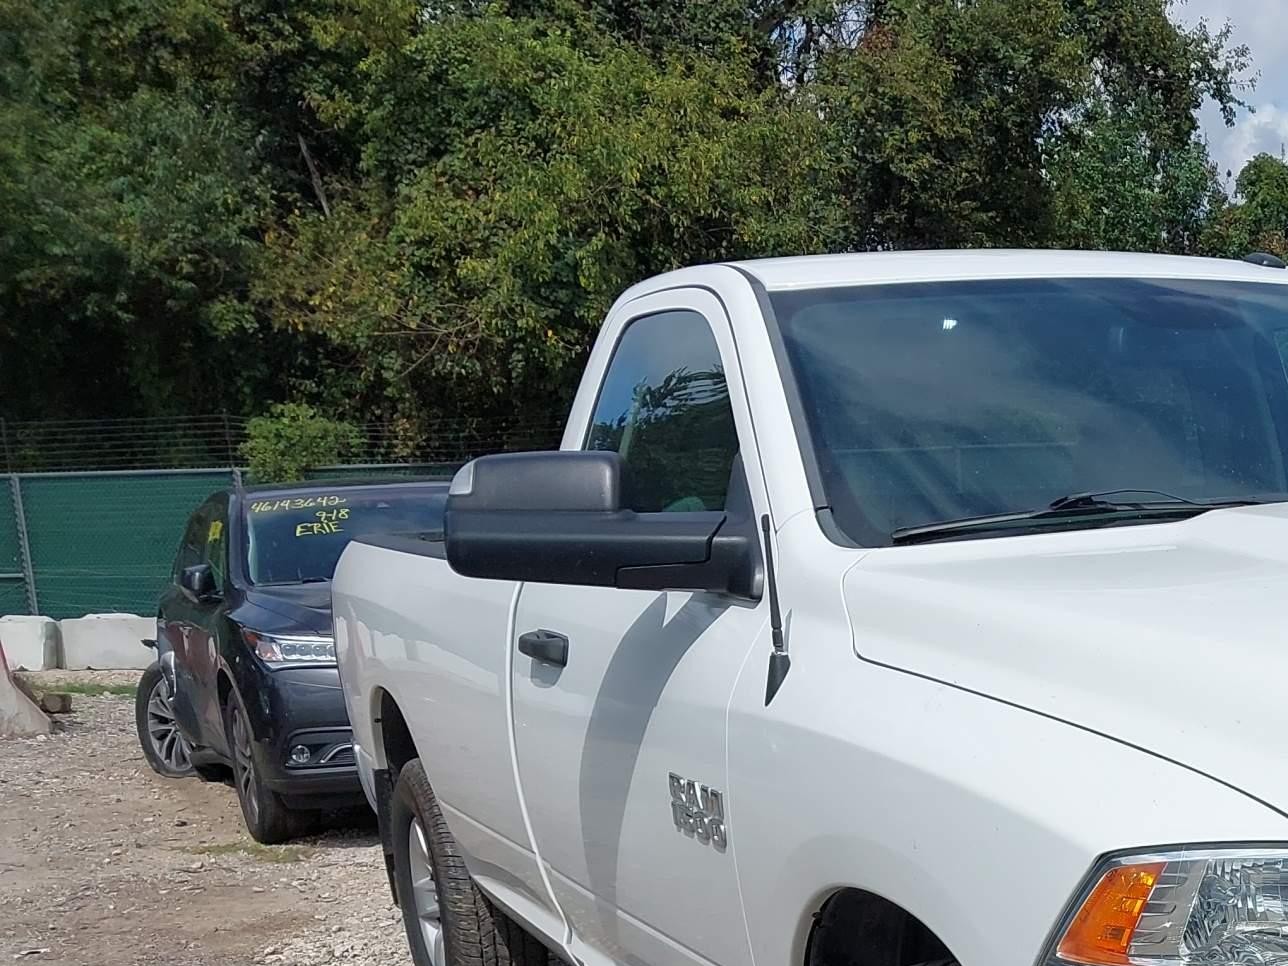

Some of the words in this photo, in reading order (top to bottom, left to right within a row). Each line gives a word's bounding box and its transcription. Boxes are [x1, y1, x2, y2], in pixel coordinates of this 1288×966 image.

[251, 496, 346, 513] 46143642
[315, 508, 350, 522] 9-18
[295, 521, 344, 537] ERIE
[668, 771, 725, 820] RAM
[671, 801, 728, 855] 1500
